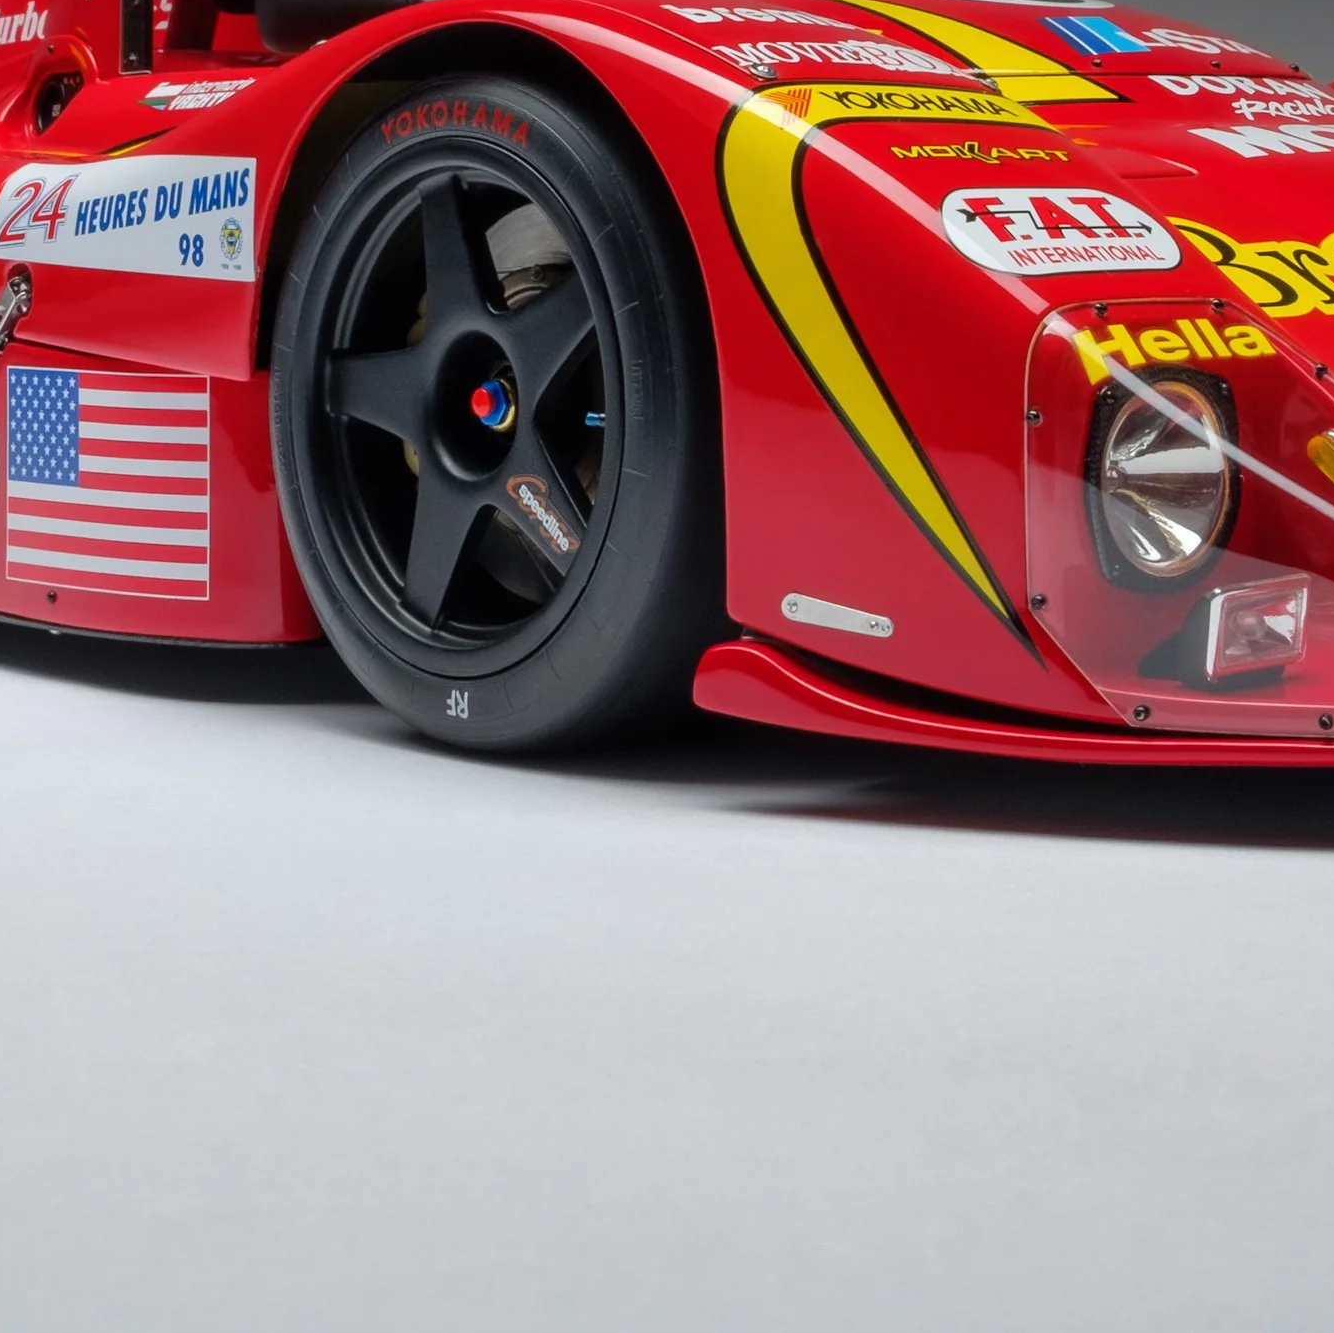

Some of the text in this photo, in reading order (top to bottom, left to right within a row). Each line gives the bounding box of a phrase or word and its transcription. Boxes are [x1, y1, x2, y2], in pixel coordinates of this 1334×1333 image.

[818, 90, 1021, 119] YOKOHAMA
[380, 100, 530, 148] YOKOHAMA
[891, 141, 1069, 164] MOKART
[74, 188, 148, 236] HEURES
[154, 181, 184, 222] DU
[188, 167, 250, 215] MANS
[178, 233, 204, 267] 98
[1008, 245, 1165, 267] INTERNATIONAL
[1072, 318, 1276, 386] Hella
[519, 484, 569, 551] speedline
[446, 689, 468, 719] RF
